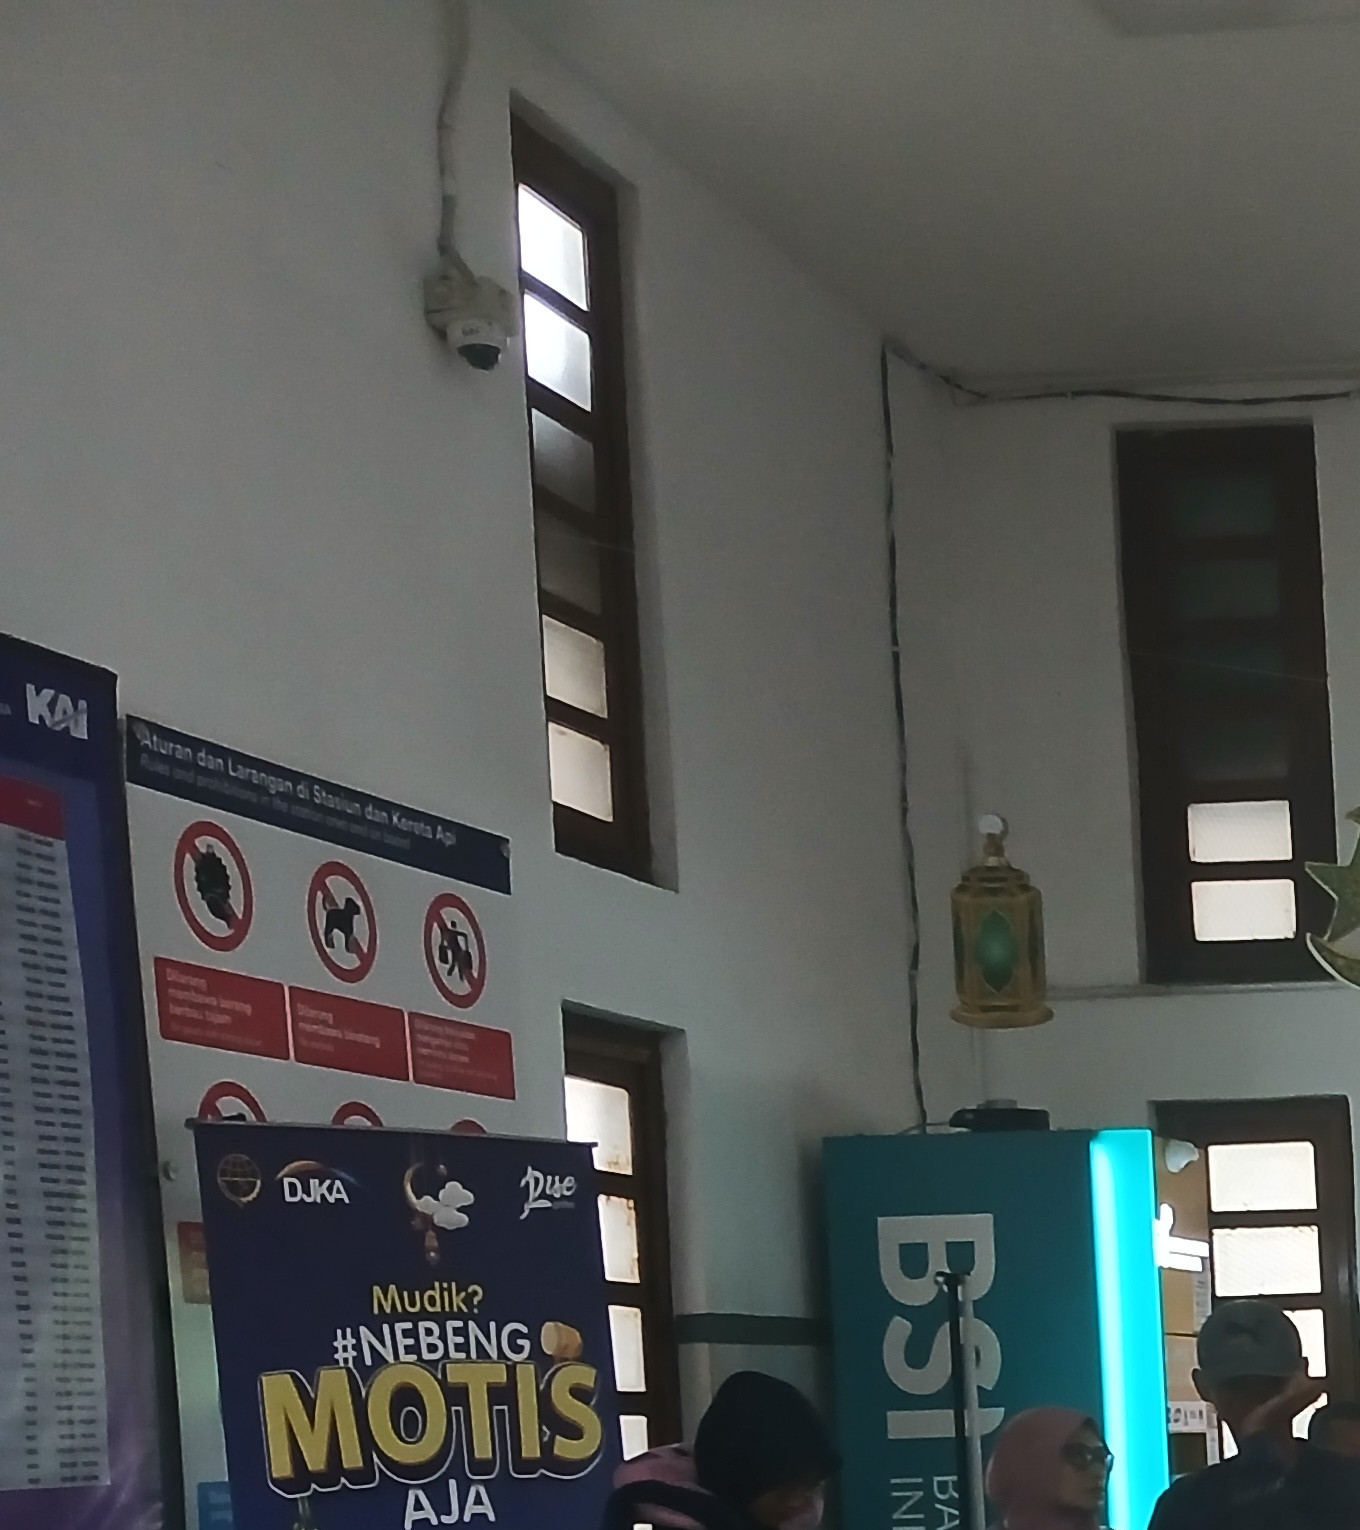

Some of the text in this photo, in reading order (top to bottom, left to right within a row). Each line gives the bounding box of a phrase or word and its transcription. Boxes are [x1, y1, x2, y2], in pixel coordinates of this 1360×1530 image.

[26, 683, 89, 740] KAI
[140, 730, 193, 760] Aturan
[197, 747, 225, 772] dan
[228, 755, 293, 795] Larangan
[296, 780, 310, 800] di
[313, 784, 361, 817] Stasiun
[364, 803, 389, 825] dan
[392, 810, 433, 839] Kereta
[435, 825, 457, 848] Api
[282, 1176, 350, 1205] DJKA
[372, 1281, 484, 1315] Mudik?
[333, 1320, 531, 1367] #NEBENG
[877, 1213, 1005, 1440] BSI
[260, 1360, 604, 1482] MOTIS
[403, 1479, 496, 1530] AJA
